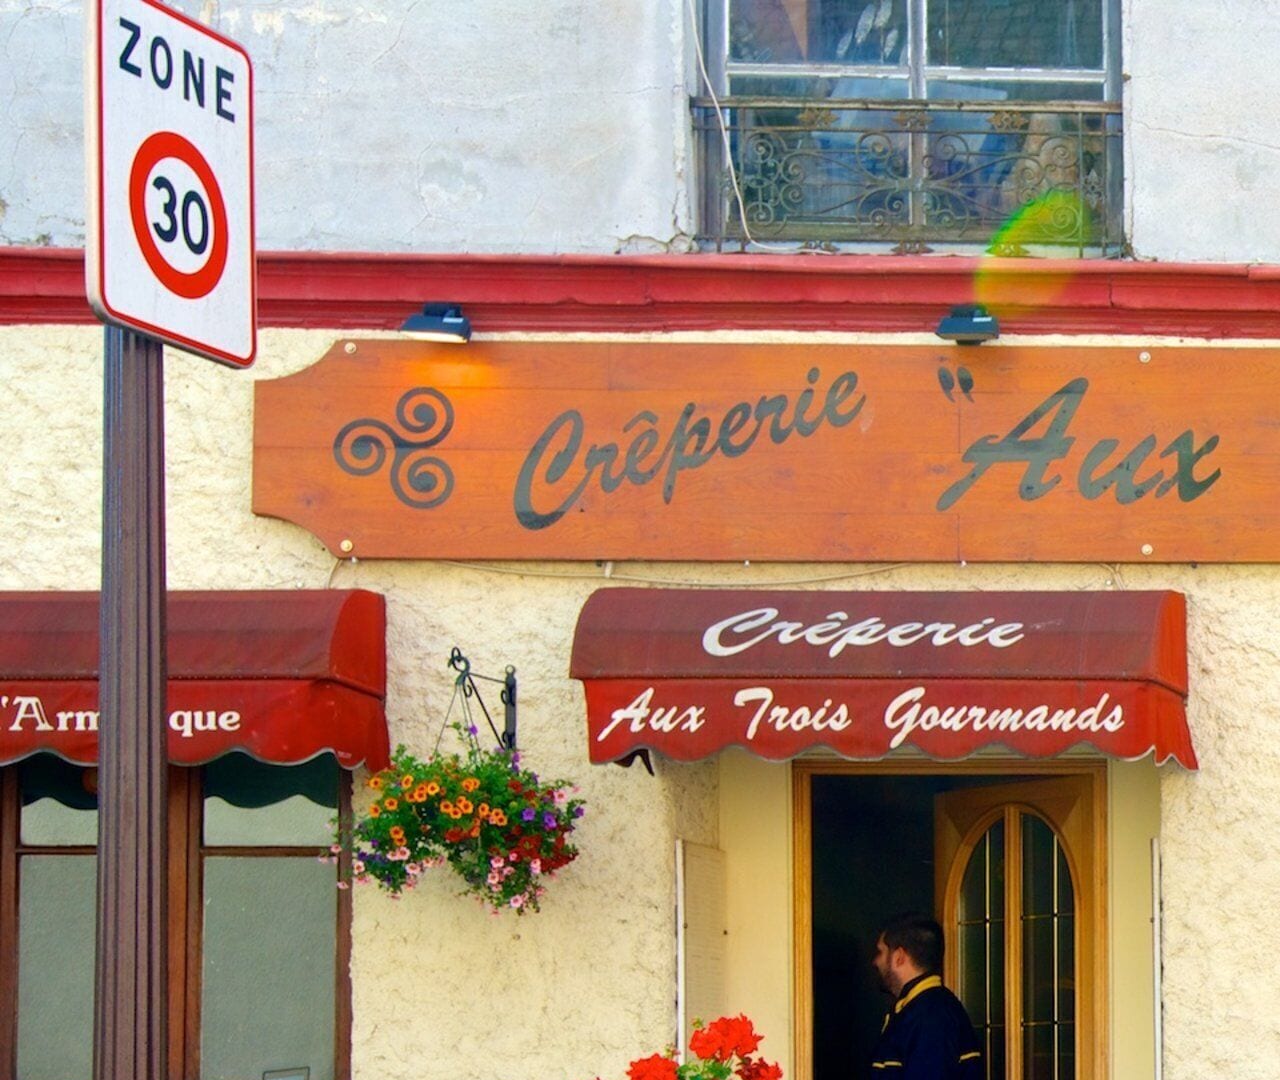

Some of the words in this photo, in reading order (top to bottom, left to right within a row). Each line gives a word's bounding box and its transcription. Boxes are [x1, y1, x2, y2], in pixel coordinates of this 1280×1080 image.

[119, 16, 235, 124] ZONE
[152, 175, 209, 256] 30
[512, 370, 867, 532] Crêperie
[702, 608, 1025, 658] Crêperie
[598, 687, 706, 743] Aux
[733, 687, 852, 741] Trois
[884, 687, 1125, 749] Gourmands
